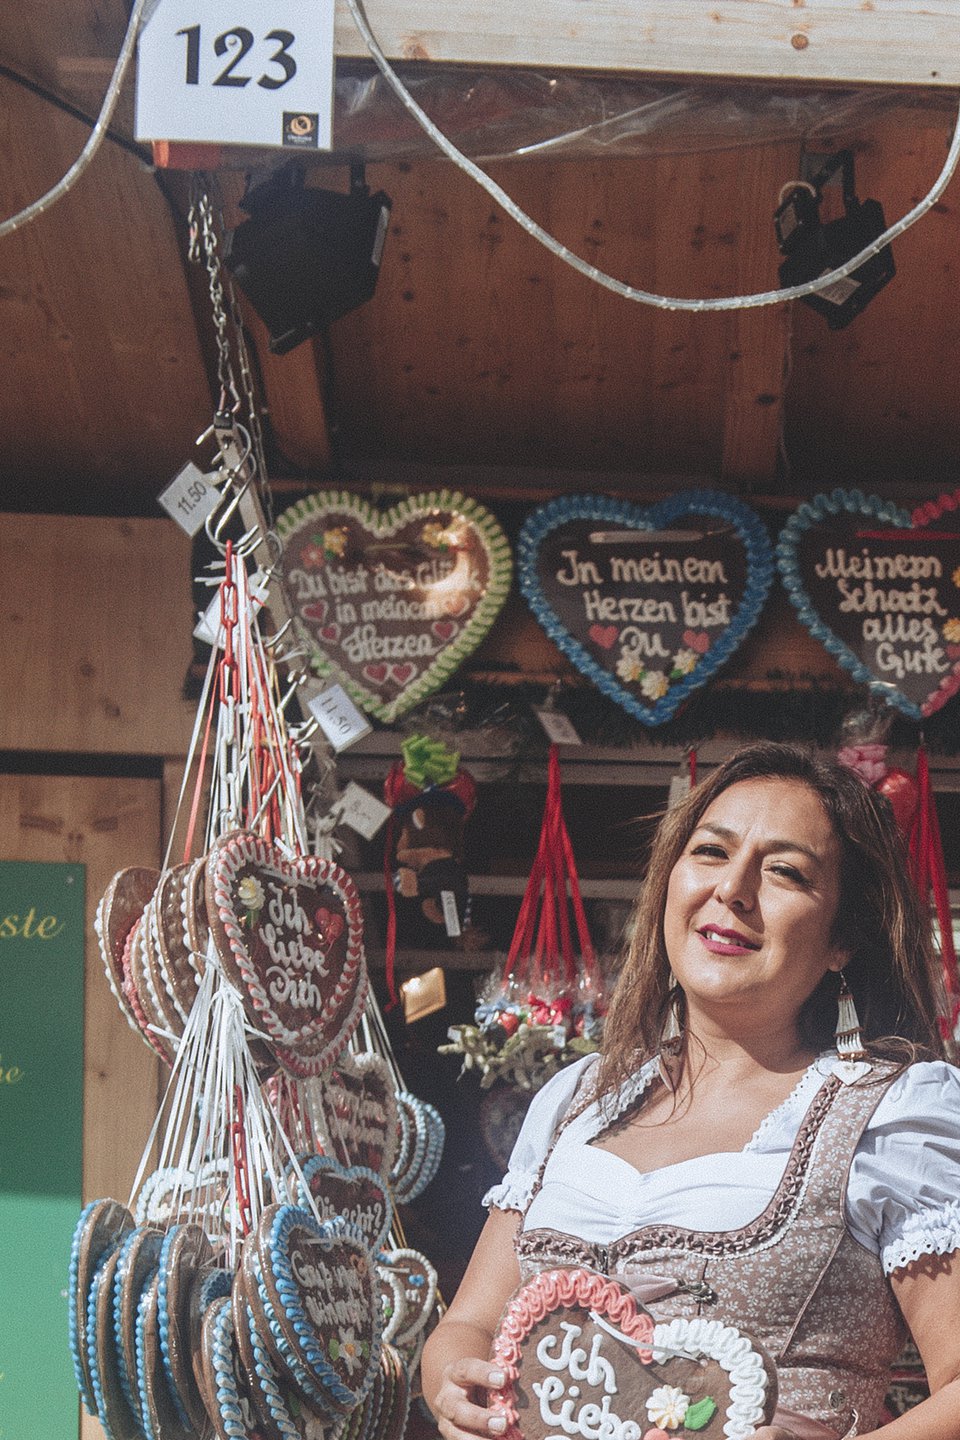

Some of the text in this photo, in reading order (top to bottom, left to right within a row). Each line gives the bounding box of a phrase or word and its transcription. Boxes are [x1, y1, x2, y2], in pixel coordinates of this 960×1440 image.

[175, 24, 298, 90] 123
[177, 478, 208, 515] 11.50
[610, 552, 728, 583] meinem
[583, 588, 732, 627] Herzen bist
[838, 578, 948, 617] Schatz
[341, 624, 444, 663] Herzen
[619, 626, 670, 657] Du
[863, 614, 939, 643] alles
